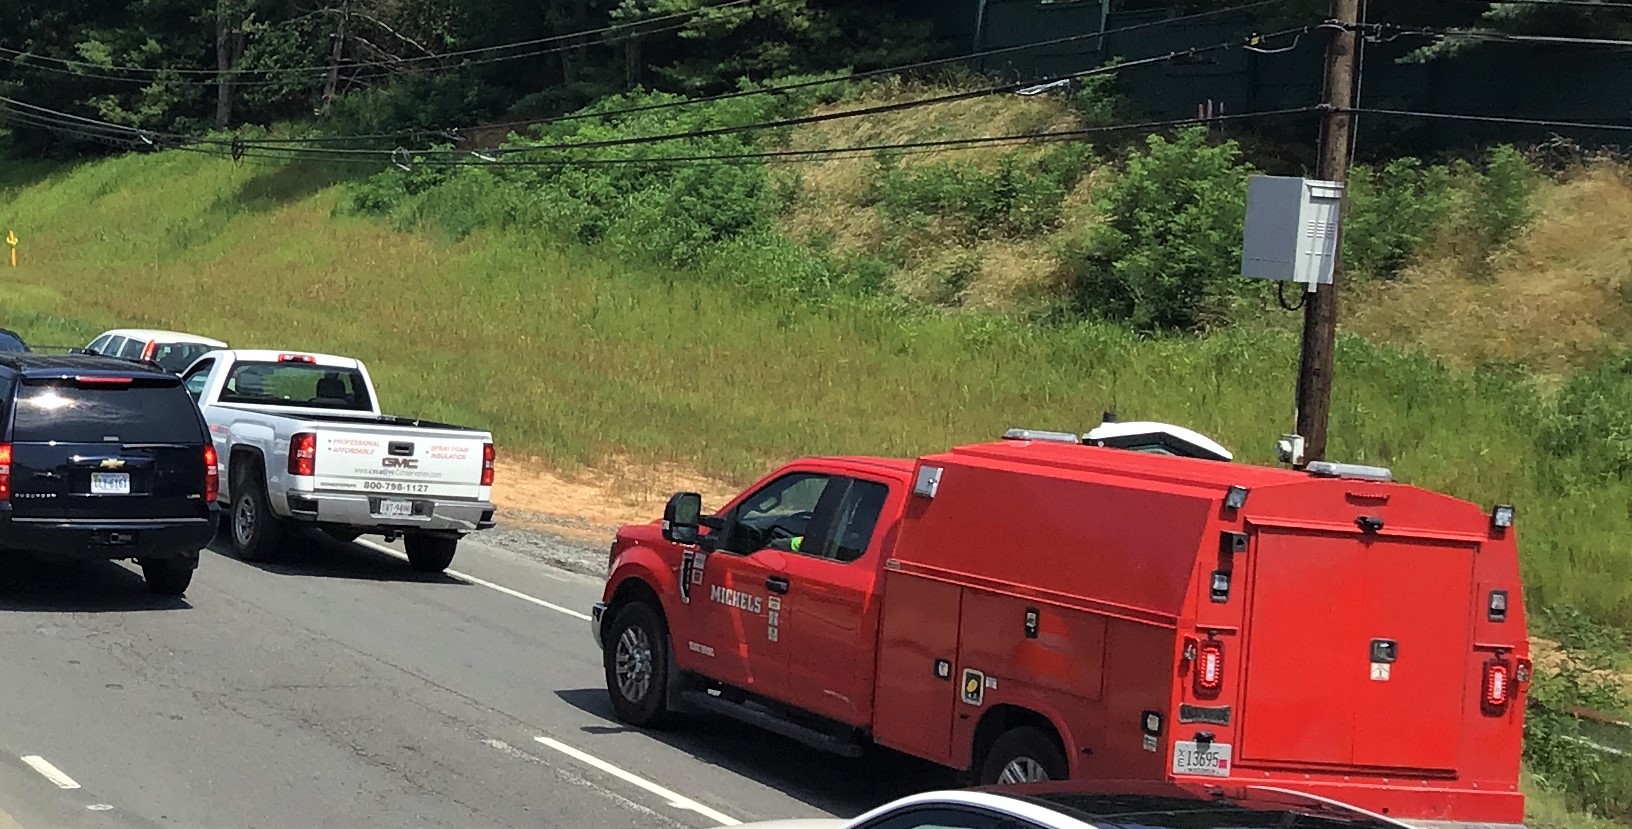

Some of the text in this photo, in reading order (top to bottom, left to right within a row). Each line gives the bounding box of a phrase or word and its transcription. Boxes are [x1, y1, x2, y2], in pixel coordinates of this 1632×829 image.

[332, 438, 380, 447] PROFESSIONAL
[332, 447, 375, 455] AFFORDABLE
[382, 457, 419, 469] GMC
[363, 481, 429, 492] 800-798-1127
[710, 584, 763, 613] MICHELS
[1186, 750, 1220, 768] 13695
